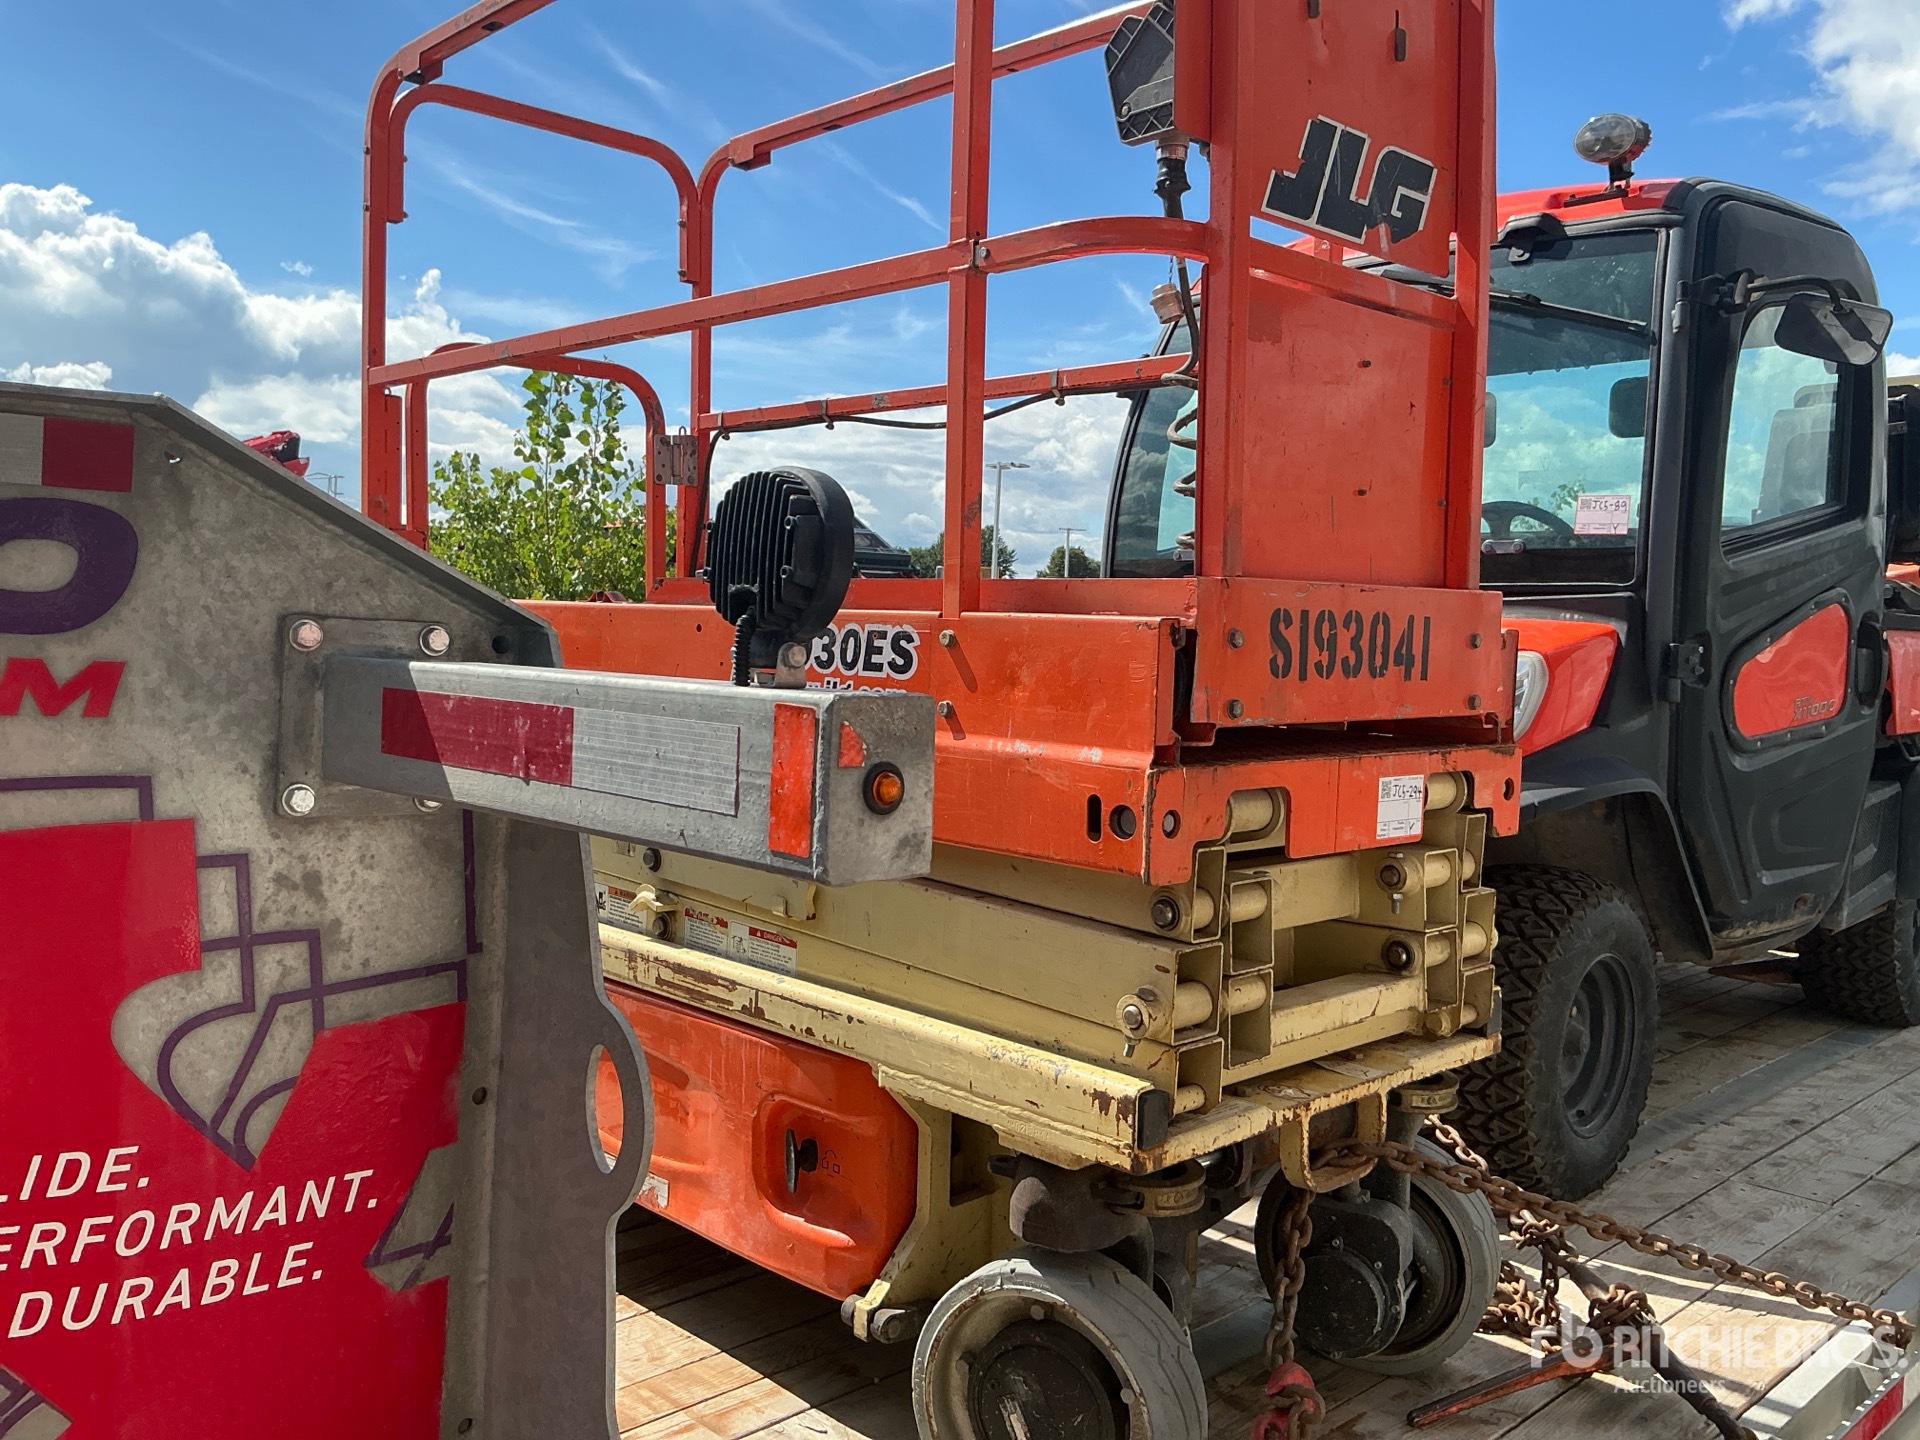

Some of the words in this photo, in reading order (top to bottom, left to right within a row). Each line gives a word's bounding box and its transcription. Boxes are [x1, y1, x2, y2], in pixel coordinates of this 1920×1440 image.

[1261, 114, 1438, 245] JLG
[806, 623, 921, 680] 30ES
[1268, 607, 1431, 682] S193041
[7, 1241, 324, 1339] DURABLE.
